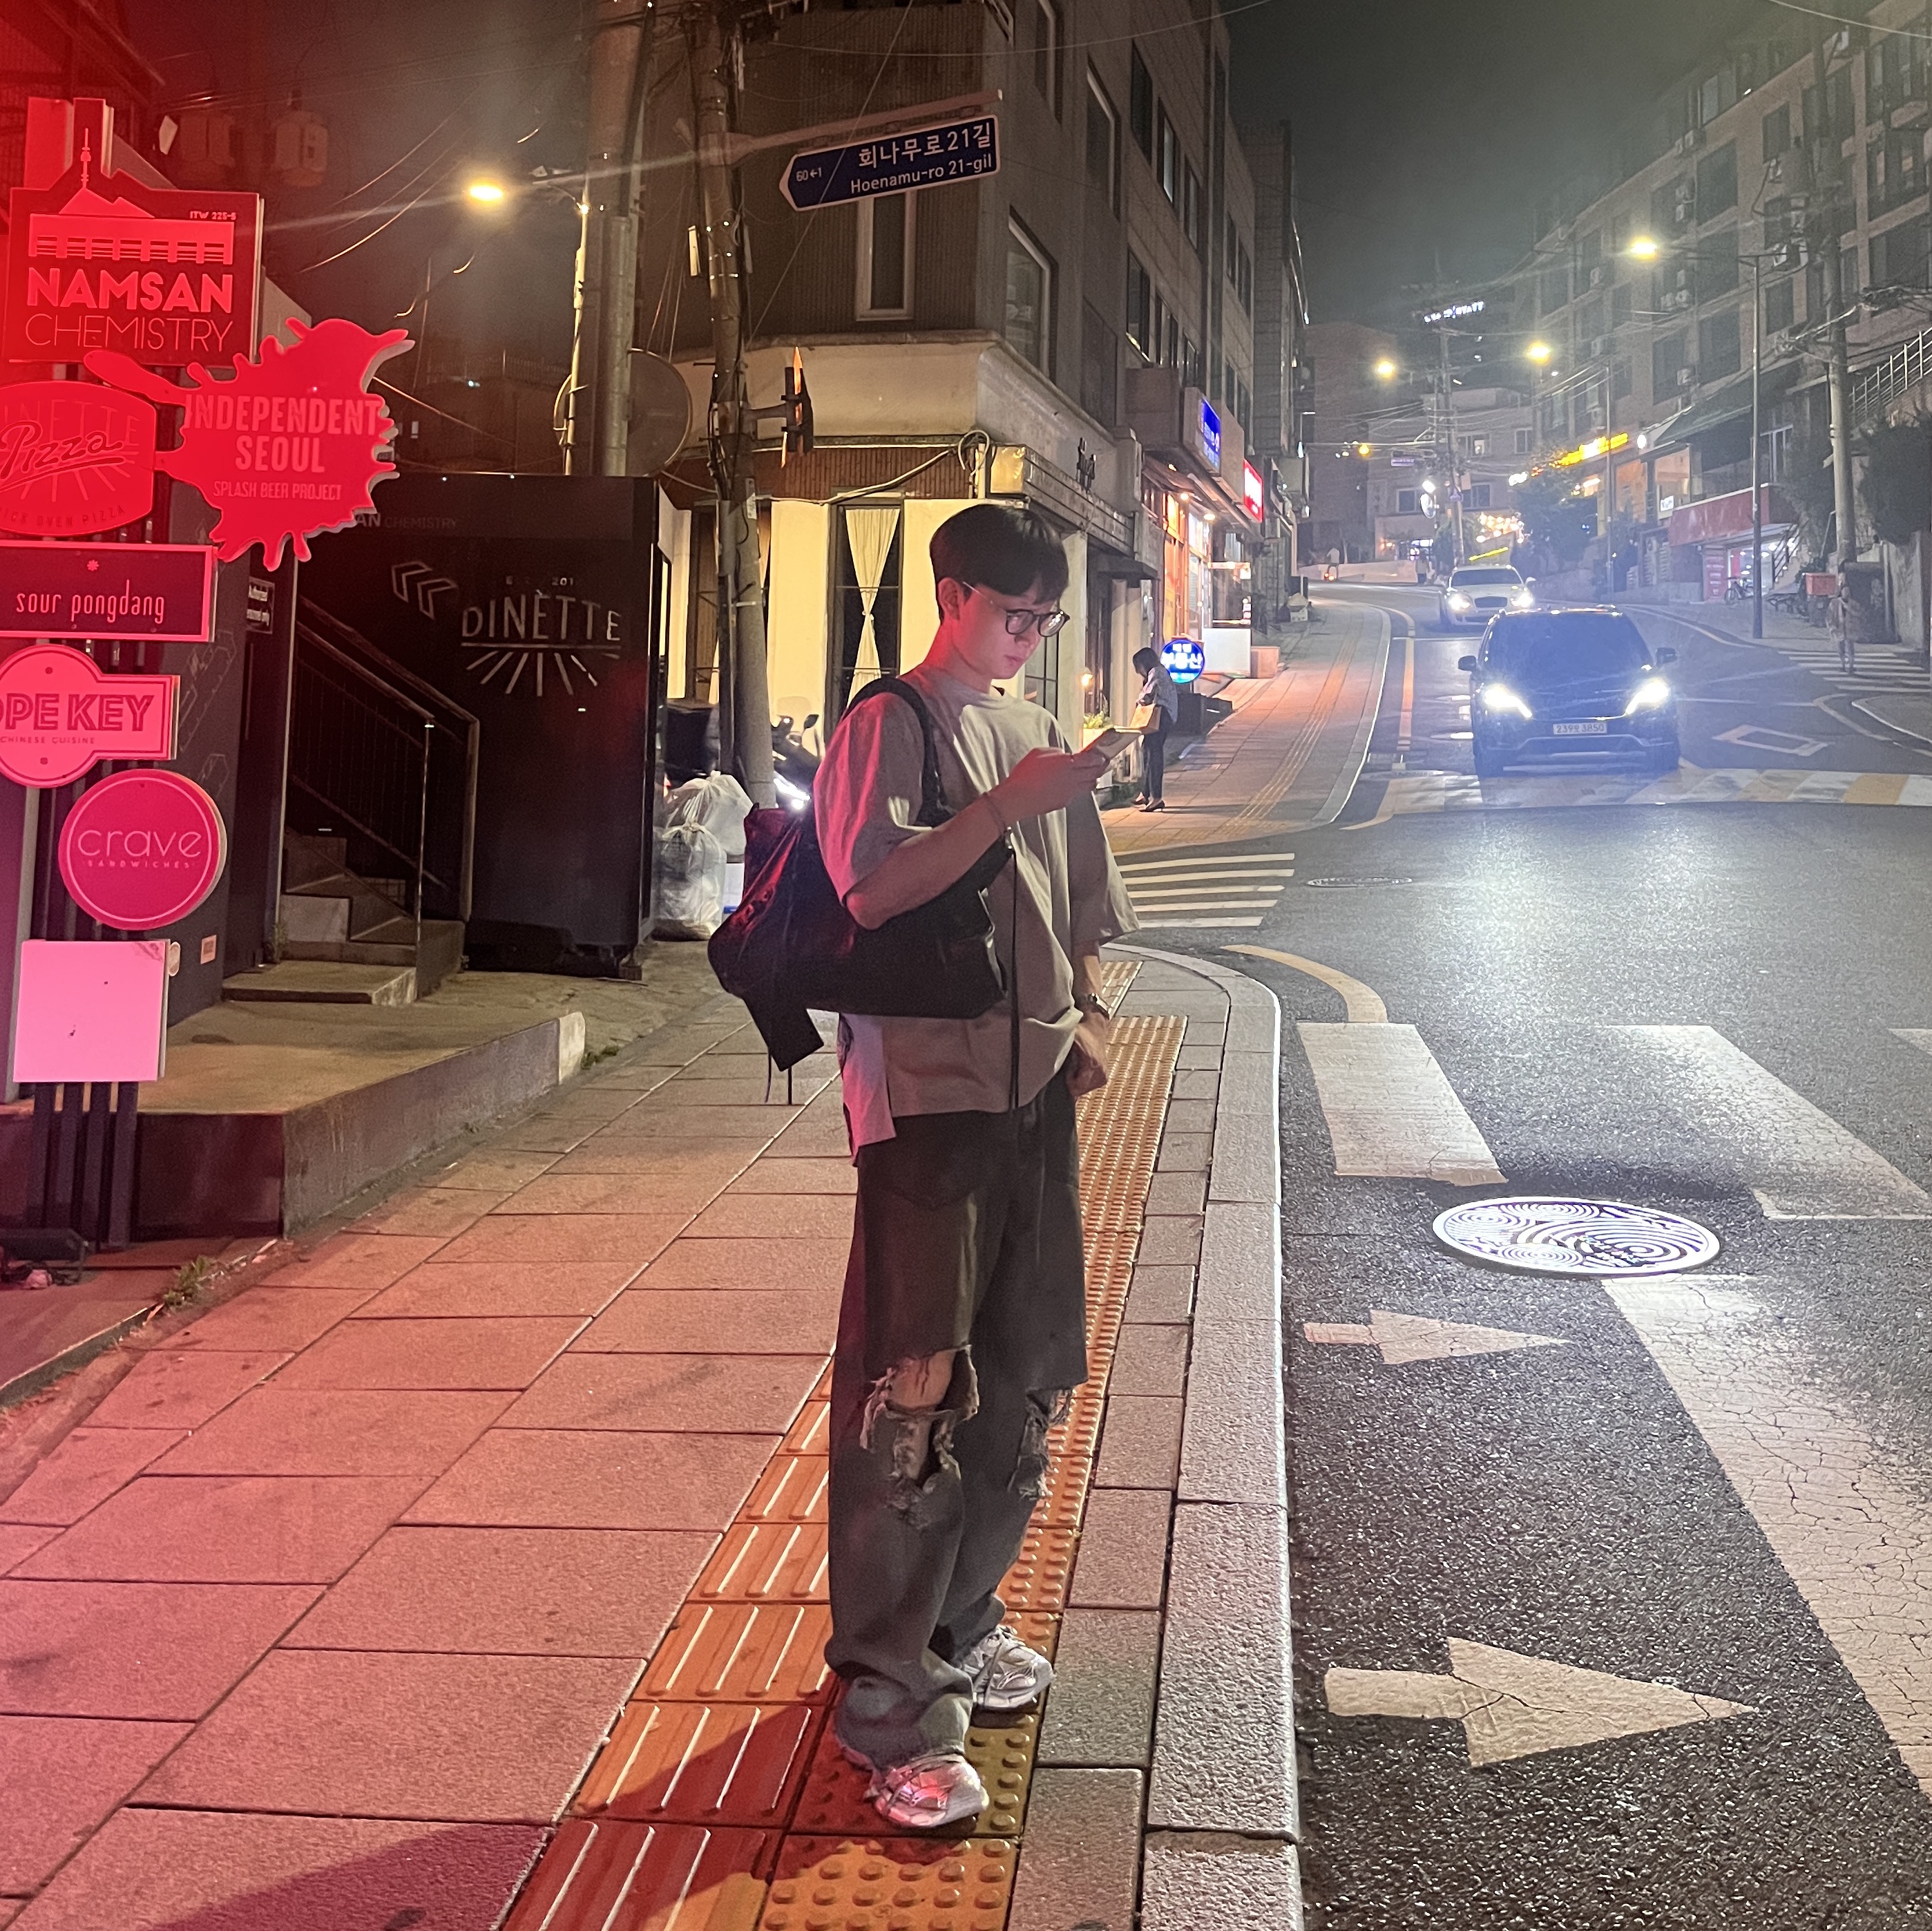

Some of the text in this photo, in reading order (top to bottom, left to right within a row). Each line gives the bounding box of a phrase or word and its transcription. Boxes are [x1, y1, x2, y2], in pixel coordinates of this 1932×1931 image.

[859, 122, 991, 169] 회나무로21길
[850, 153, 993, 195] Hoenamu-ro 21-gil
[189, 211, 209, 219] ITW
[27, 267, 233, 314] NAMSAN
[25, 313, 233, 352] CHEMISTRY
[183, 394, 381, 436] INDEPENDENT
[0, 420, 123, 479] Pizza
[234, 435, 325, 473] SEOUL
[213, 481, 343, 501] SPLASH BEER PROJECT
[82, 504, 125, 523] PIZZA
[384, 519, 457, 529] CHEMISTRY
[16, 579, 165, 625] sour pongdang
[461, 593, 622, 641] DINETTE
[0, 692, 155, 732] PE KEY
[78, 830, 202, 857] crave
[87, 859, 190, 868] SANDWICHES
